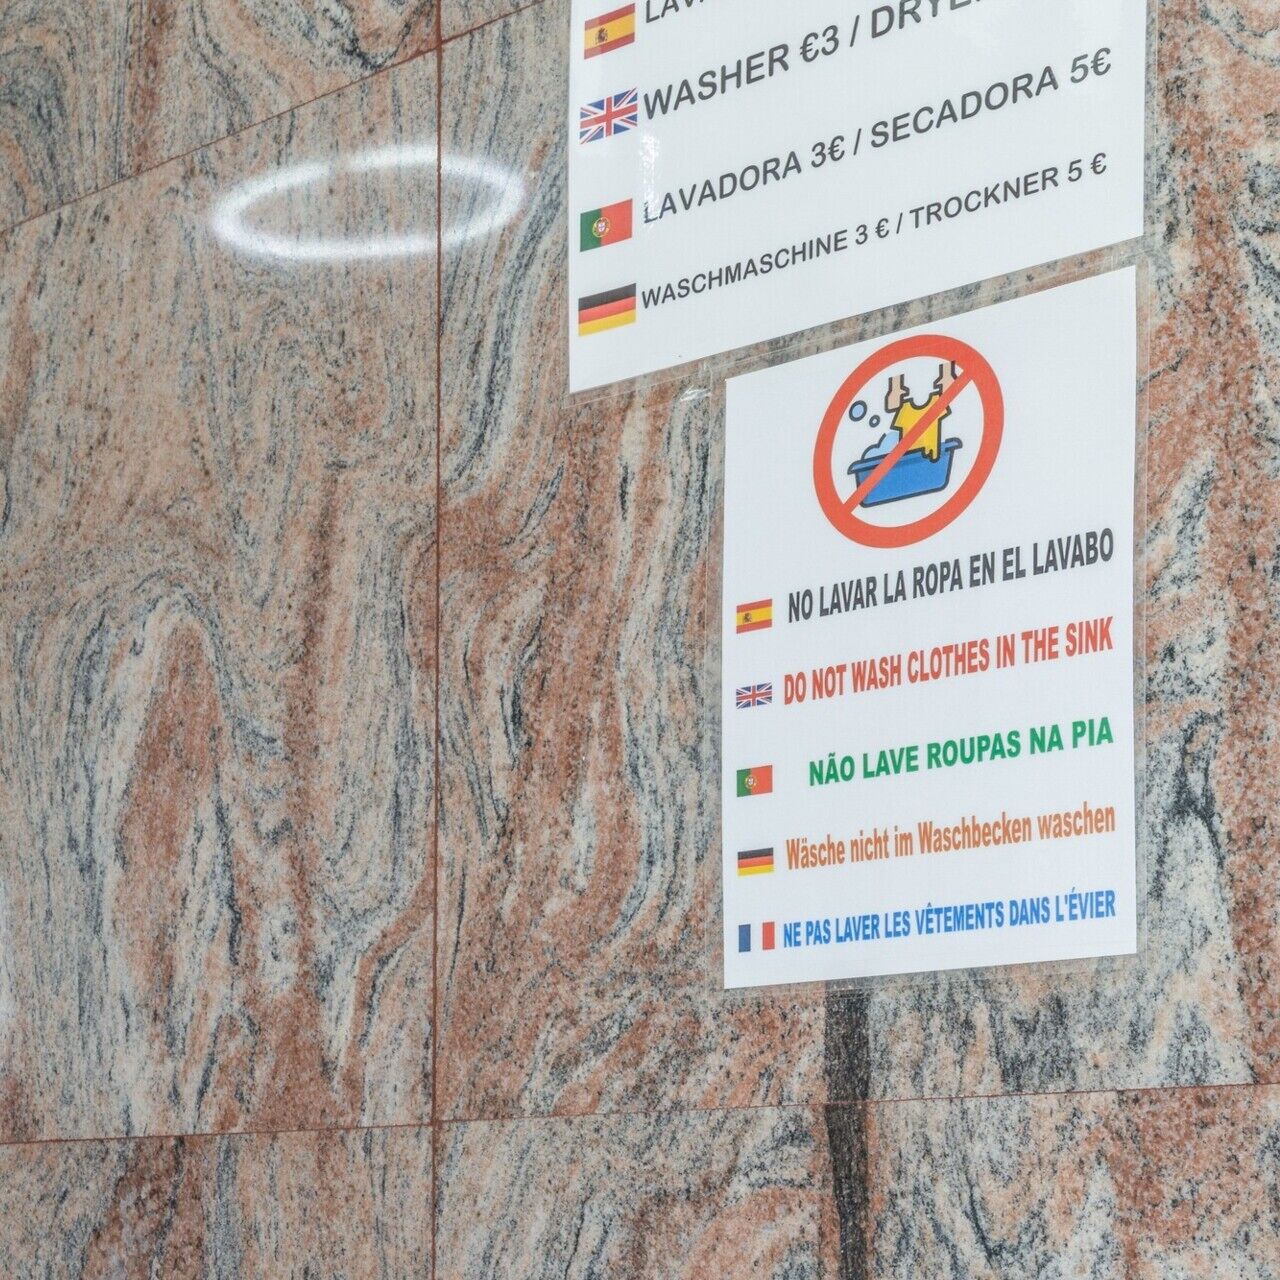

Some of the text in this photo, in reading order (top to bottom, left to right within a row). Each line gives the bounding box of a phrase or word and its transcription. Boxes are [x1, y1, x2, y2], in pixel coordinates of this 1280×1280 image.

[643, 0, 981, 120] WASHER €3 / DRY
[643, 47, 1112, 224] LAVADORA 3€ / SECADORA 5€
[641, 152, 1107, 309] WASCHMASCHINE 3 € / TROCKNER 5 €
[788, 527, 1114, 623] NO LAVAR LA ROPA EN EL LAVABO
[784, 616, 1114, 705] DO NOT WASH CLOTHES IN THE SINK
[809, 716, 1114, 787] NÃO LAVE ROUPAS NA PIA
[786, 800, 1116, 870] Wäsche nicht im Waschbecken waschen
[783, 887, 1116, 949] NE PAS LAVER LES VÊTEMENTS DANS L'ÉVIER
